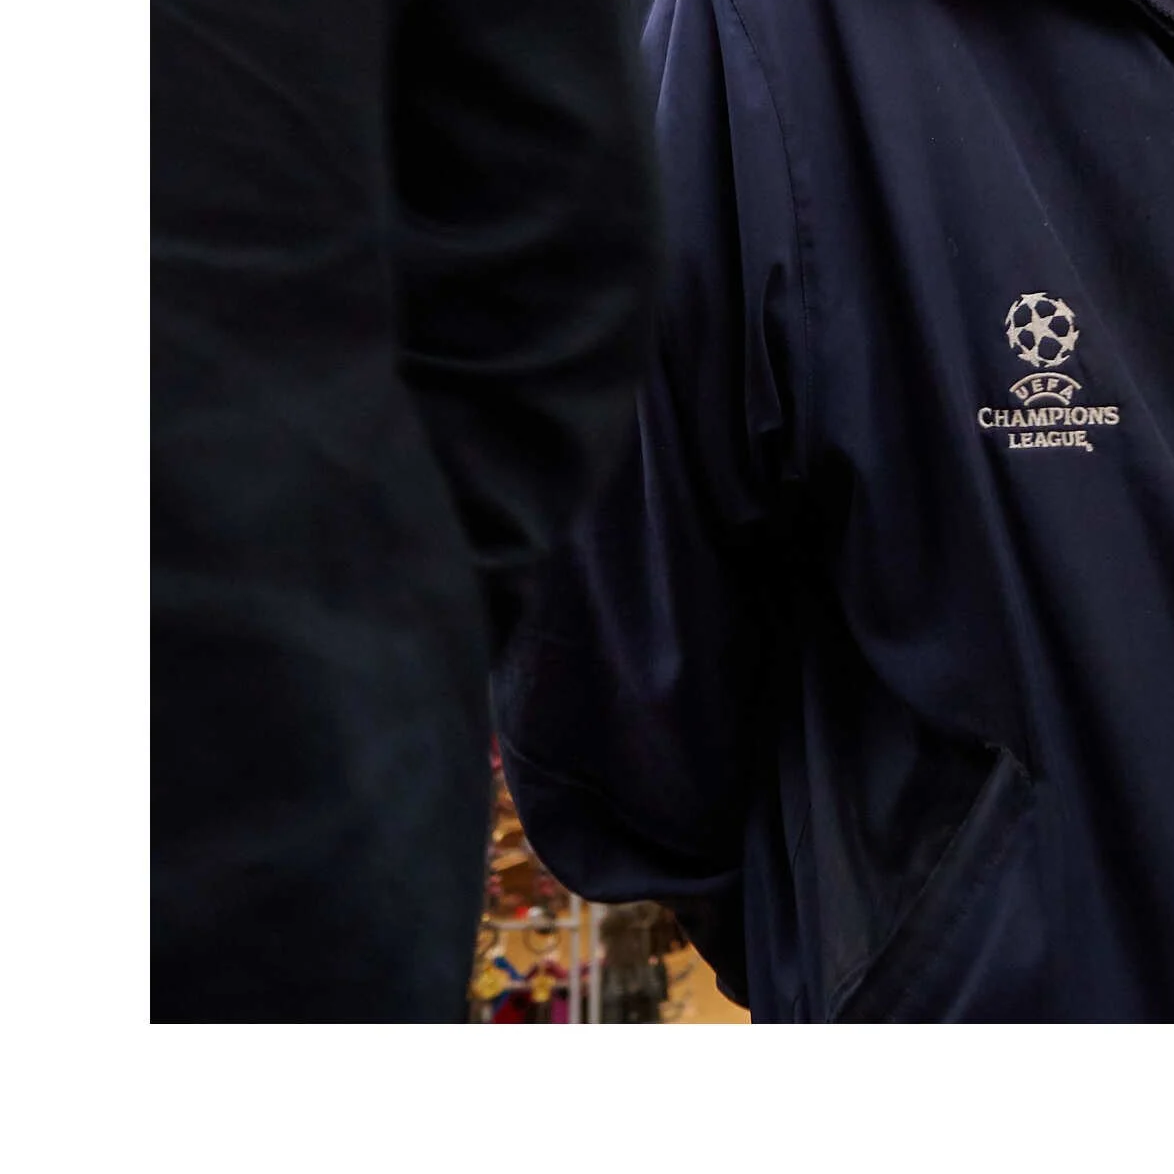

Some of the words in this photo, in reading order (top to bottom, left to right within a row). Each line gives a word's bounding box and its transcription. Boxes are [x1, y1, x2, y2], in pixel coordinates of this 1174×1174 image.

[1015, 378, 1074, 400] UEFA
[977, 406, 1120, 428] CHAMPIONS
[1007, 430, 1088, 449] LEAGUE
